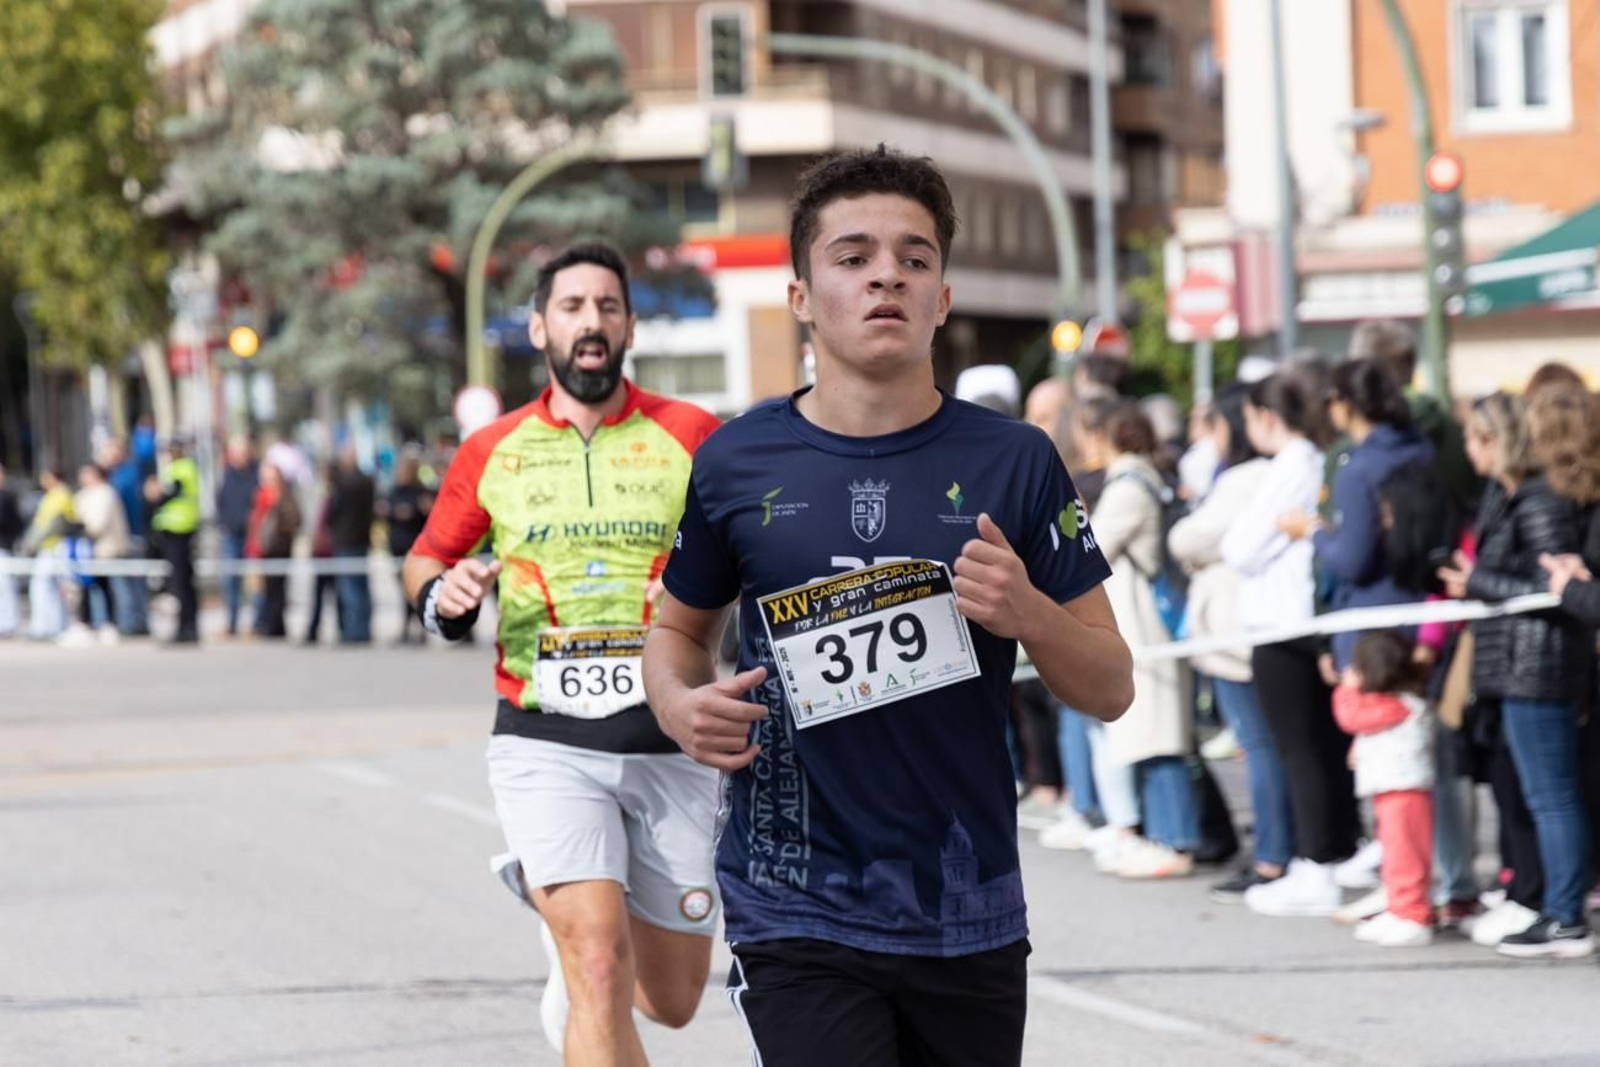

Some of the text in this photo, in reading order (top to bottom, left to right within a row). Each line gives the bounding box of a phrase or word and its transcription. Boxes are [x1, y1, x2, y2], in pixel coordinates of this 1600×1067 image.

[564, 521, 667, 538] HYUNDAI
[810, 573, 873, 600] CARRERA
[813, 570, 941, 613] y gran caminata
[768, 592, 808, 625] XXV
[815, 612, 829, 626] LA
[859, 600, 872, 614] LA
[815, 612, 928, 685] 379
[560, 664, 633, 697] 636
[754, 786, 775, 856] SANTA
[780, 829, 801, 858] DE
